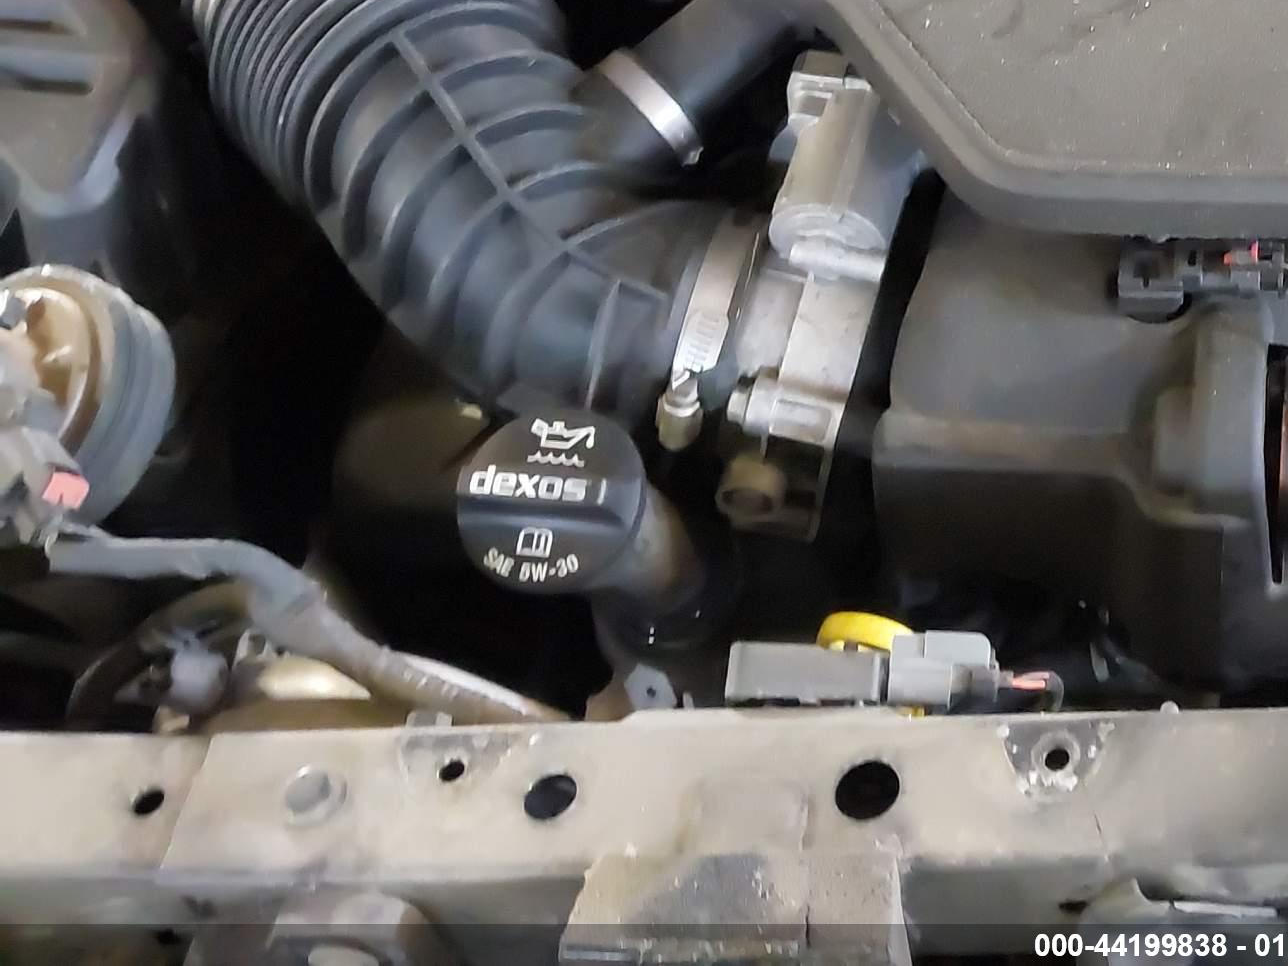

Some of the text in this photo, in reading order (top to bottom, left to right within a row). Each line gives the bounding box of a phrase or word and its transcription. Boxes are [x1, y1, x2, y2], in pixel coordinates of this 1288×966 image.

[469, 464, 588, 502] dexos
[483, 546, 579, 583] SAE 5W-30
